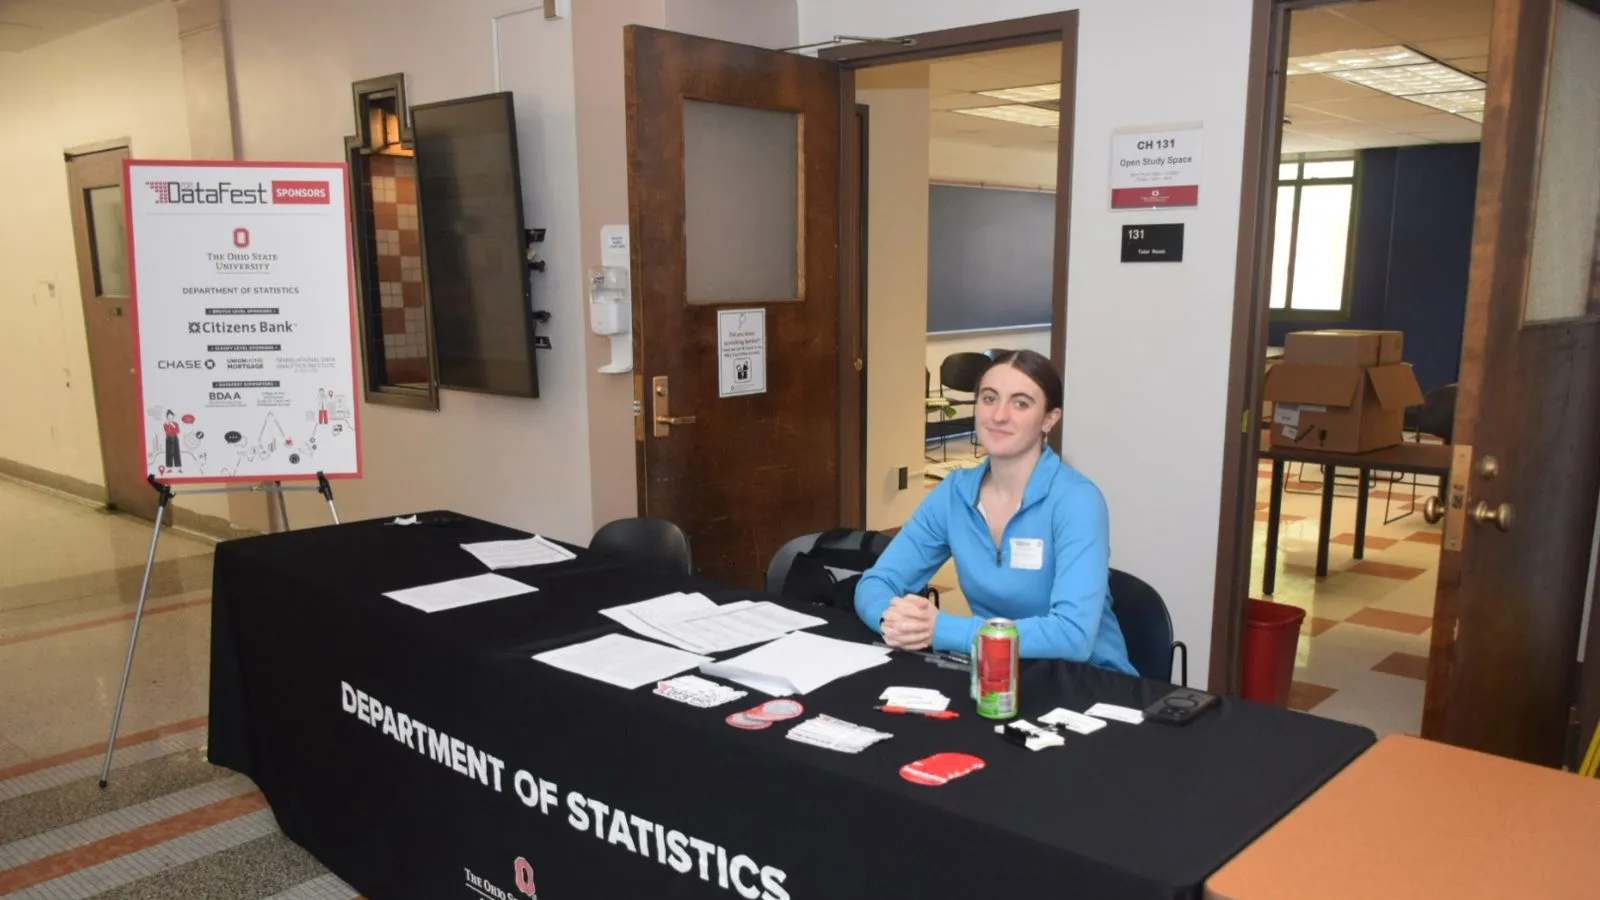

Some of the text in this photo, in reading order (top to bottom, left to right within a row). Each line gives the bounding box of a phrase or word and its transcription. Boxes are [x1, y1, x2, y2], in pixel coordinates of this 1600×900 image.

[1137, 139, 1175, 150] CH 131
[1120, 156, 1192, 168] Open Study Space
[167, 181, 267, 204] DataFest
[276, 188, 326, 198] SPONSORS
[1128, 229, 1144, 240] 131
[216, 262, 270, 270] UNIVERSITY
[182, 286, 300, 294] DEPARTMENT OF STATISTICS
[202, 320, 293, 334] Citizens Bank
[158, 360, 202, 369] CHASE
[209, 392, 242, 400] BDAA
[341, 680, 790, 900] DEPARTMENT OF STATISTICS
